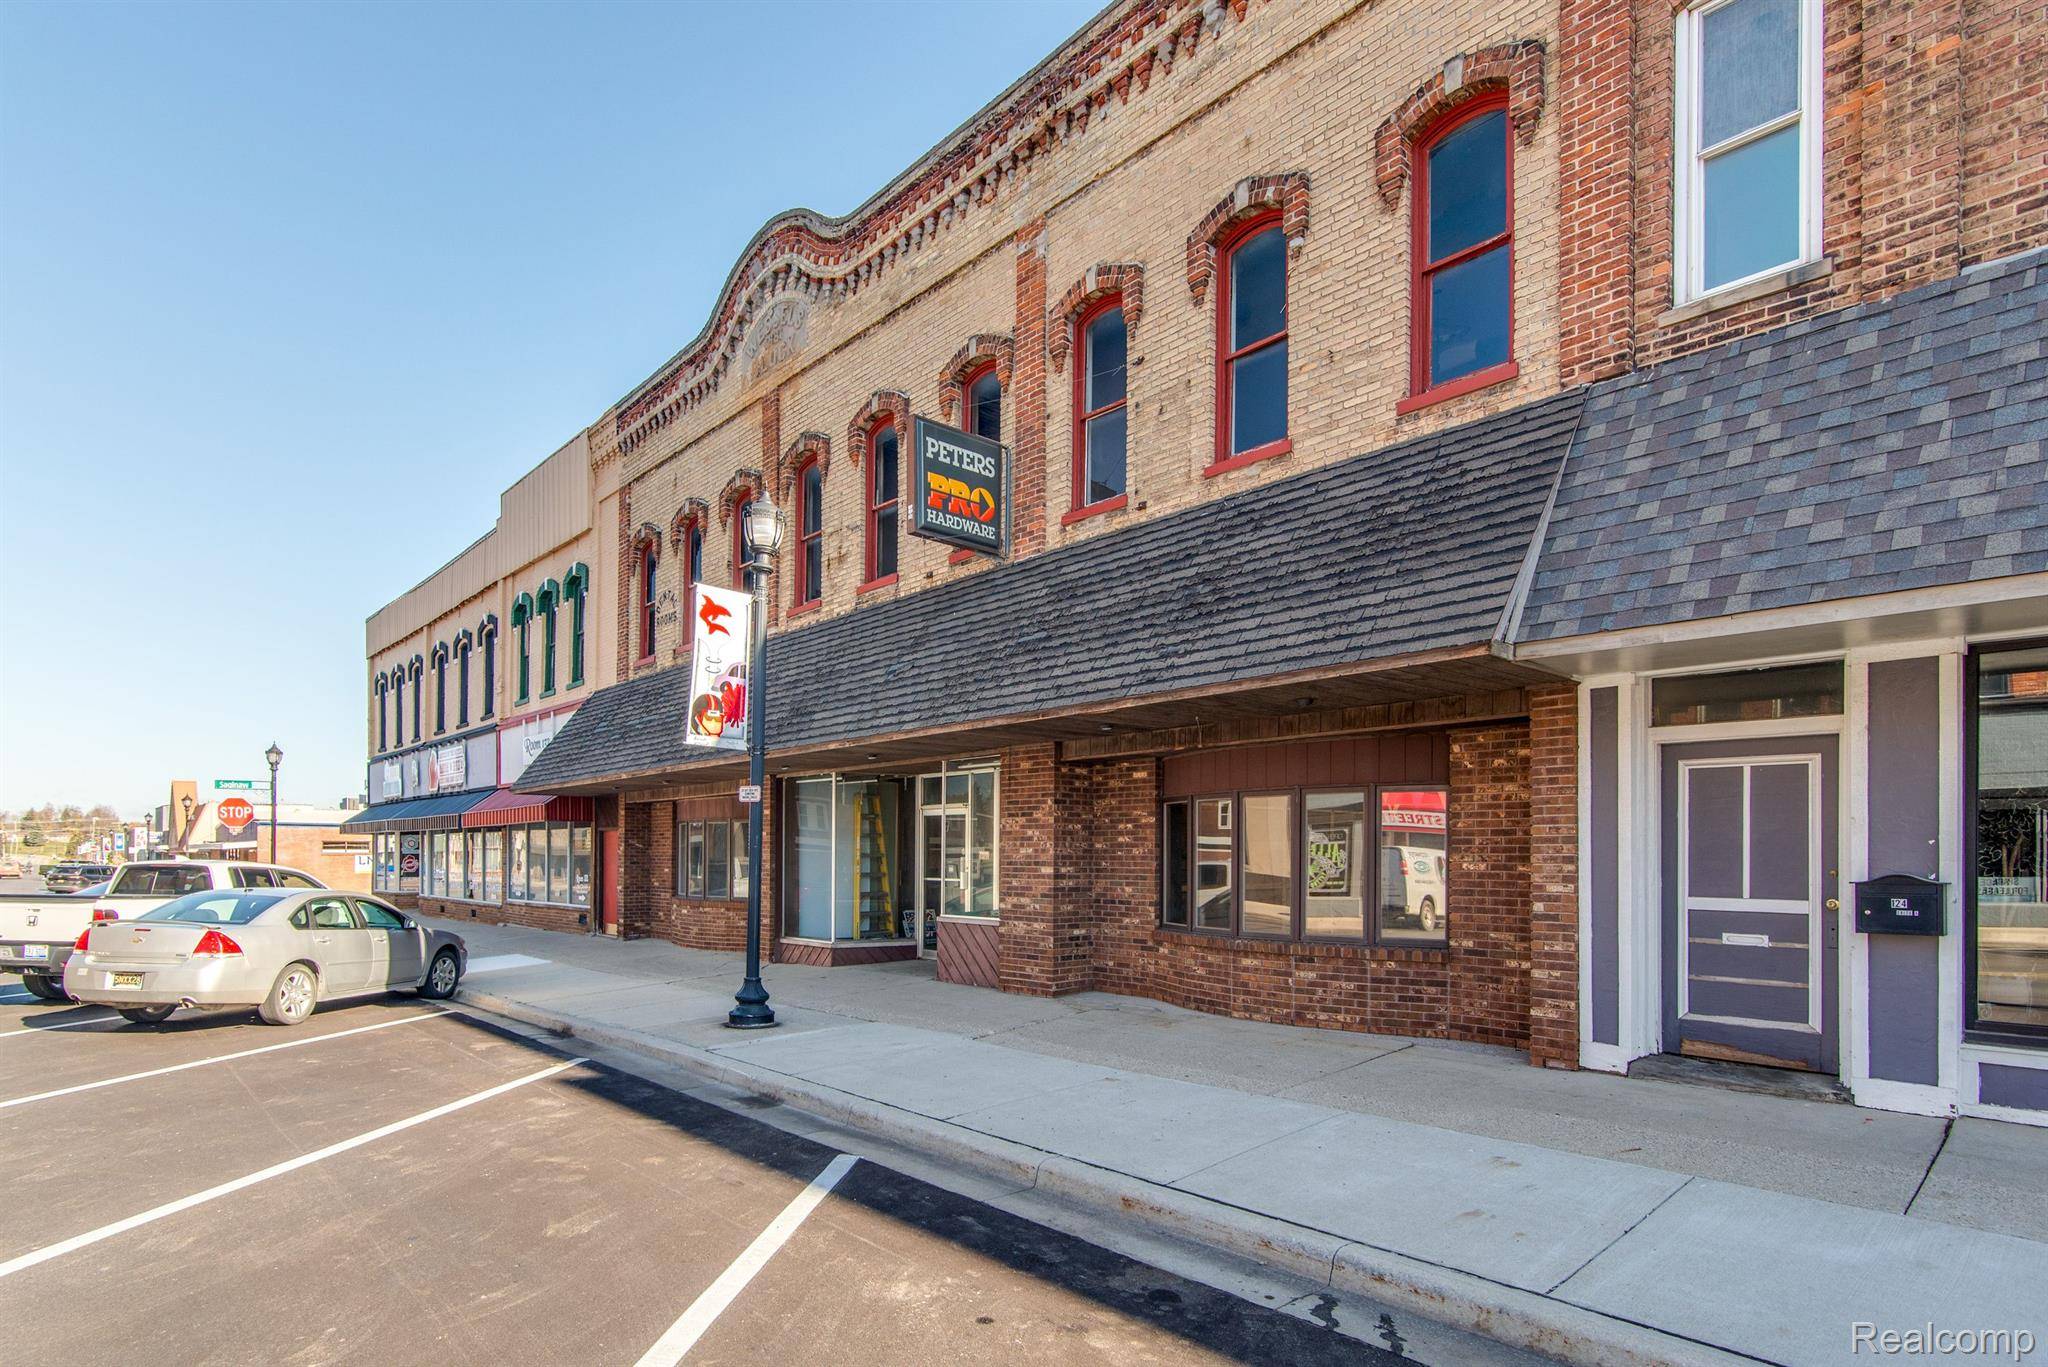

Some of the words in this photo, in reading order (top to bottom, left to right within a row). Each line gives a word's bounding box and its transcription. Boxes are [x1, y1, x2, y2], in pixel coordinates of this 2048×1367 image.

[926, 436, 995, 478] PETERS
[928, 471, 995, 523] PRO
[926, 508, 995, 539] HARDWARE
[220, 806, 252, 818] STOP
[1891, 899, 1907, 908] 124
